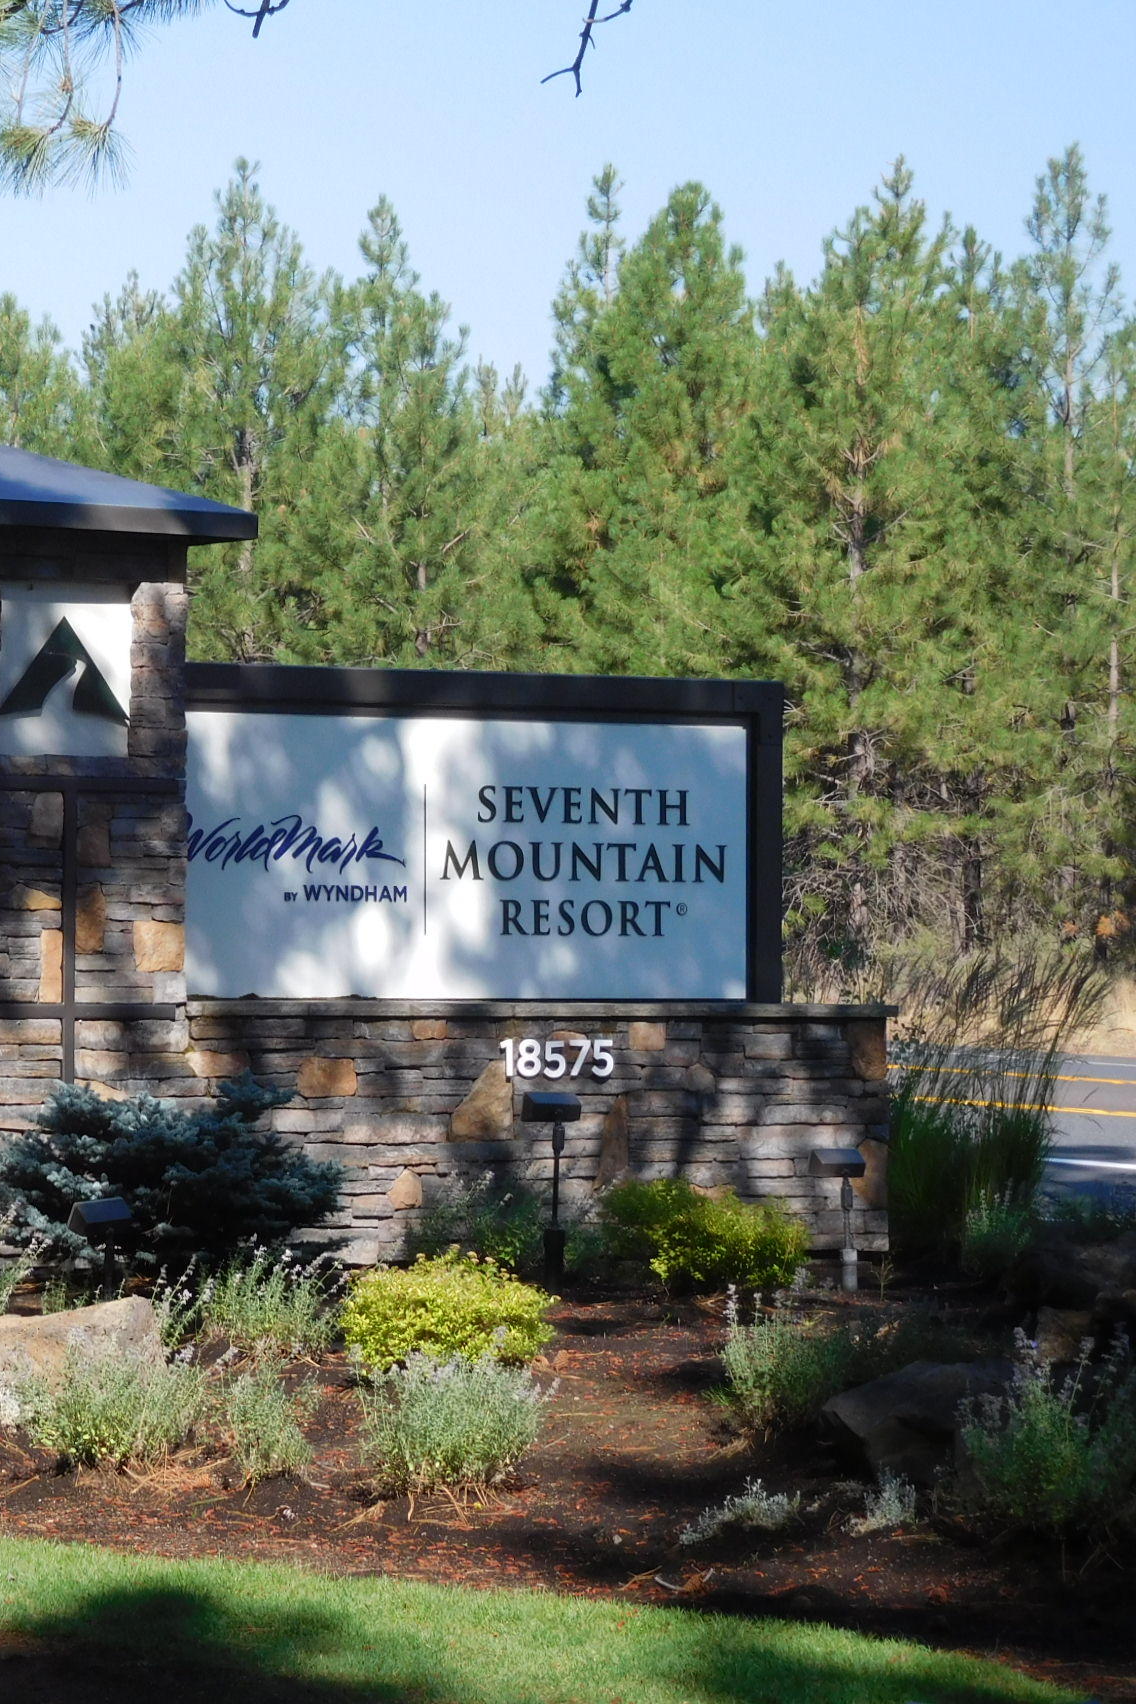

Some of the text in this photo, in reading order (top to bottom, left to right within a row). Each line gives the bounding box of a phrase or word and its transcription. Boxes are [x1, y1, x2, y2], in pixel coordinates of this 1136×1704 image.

[477, 785, 691, 826] SEVENTH
[439, 839, 728, 883] MOUNTAIN
[284, 884, 408, 903] BY WYNDHAM
[499, 1038, 614, 1080] 18575
